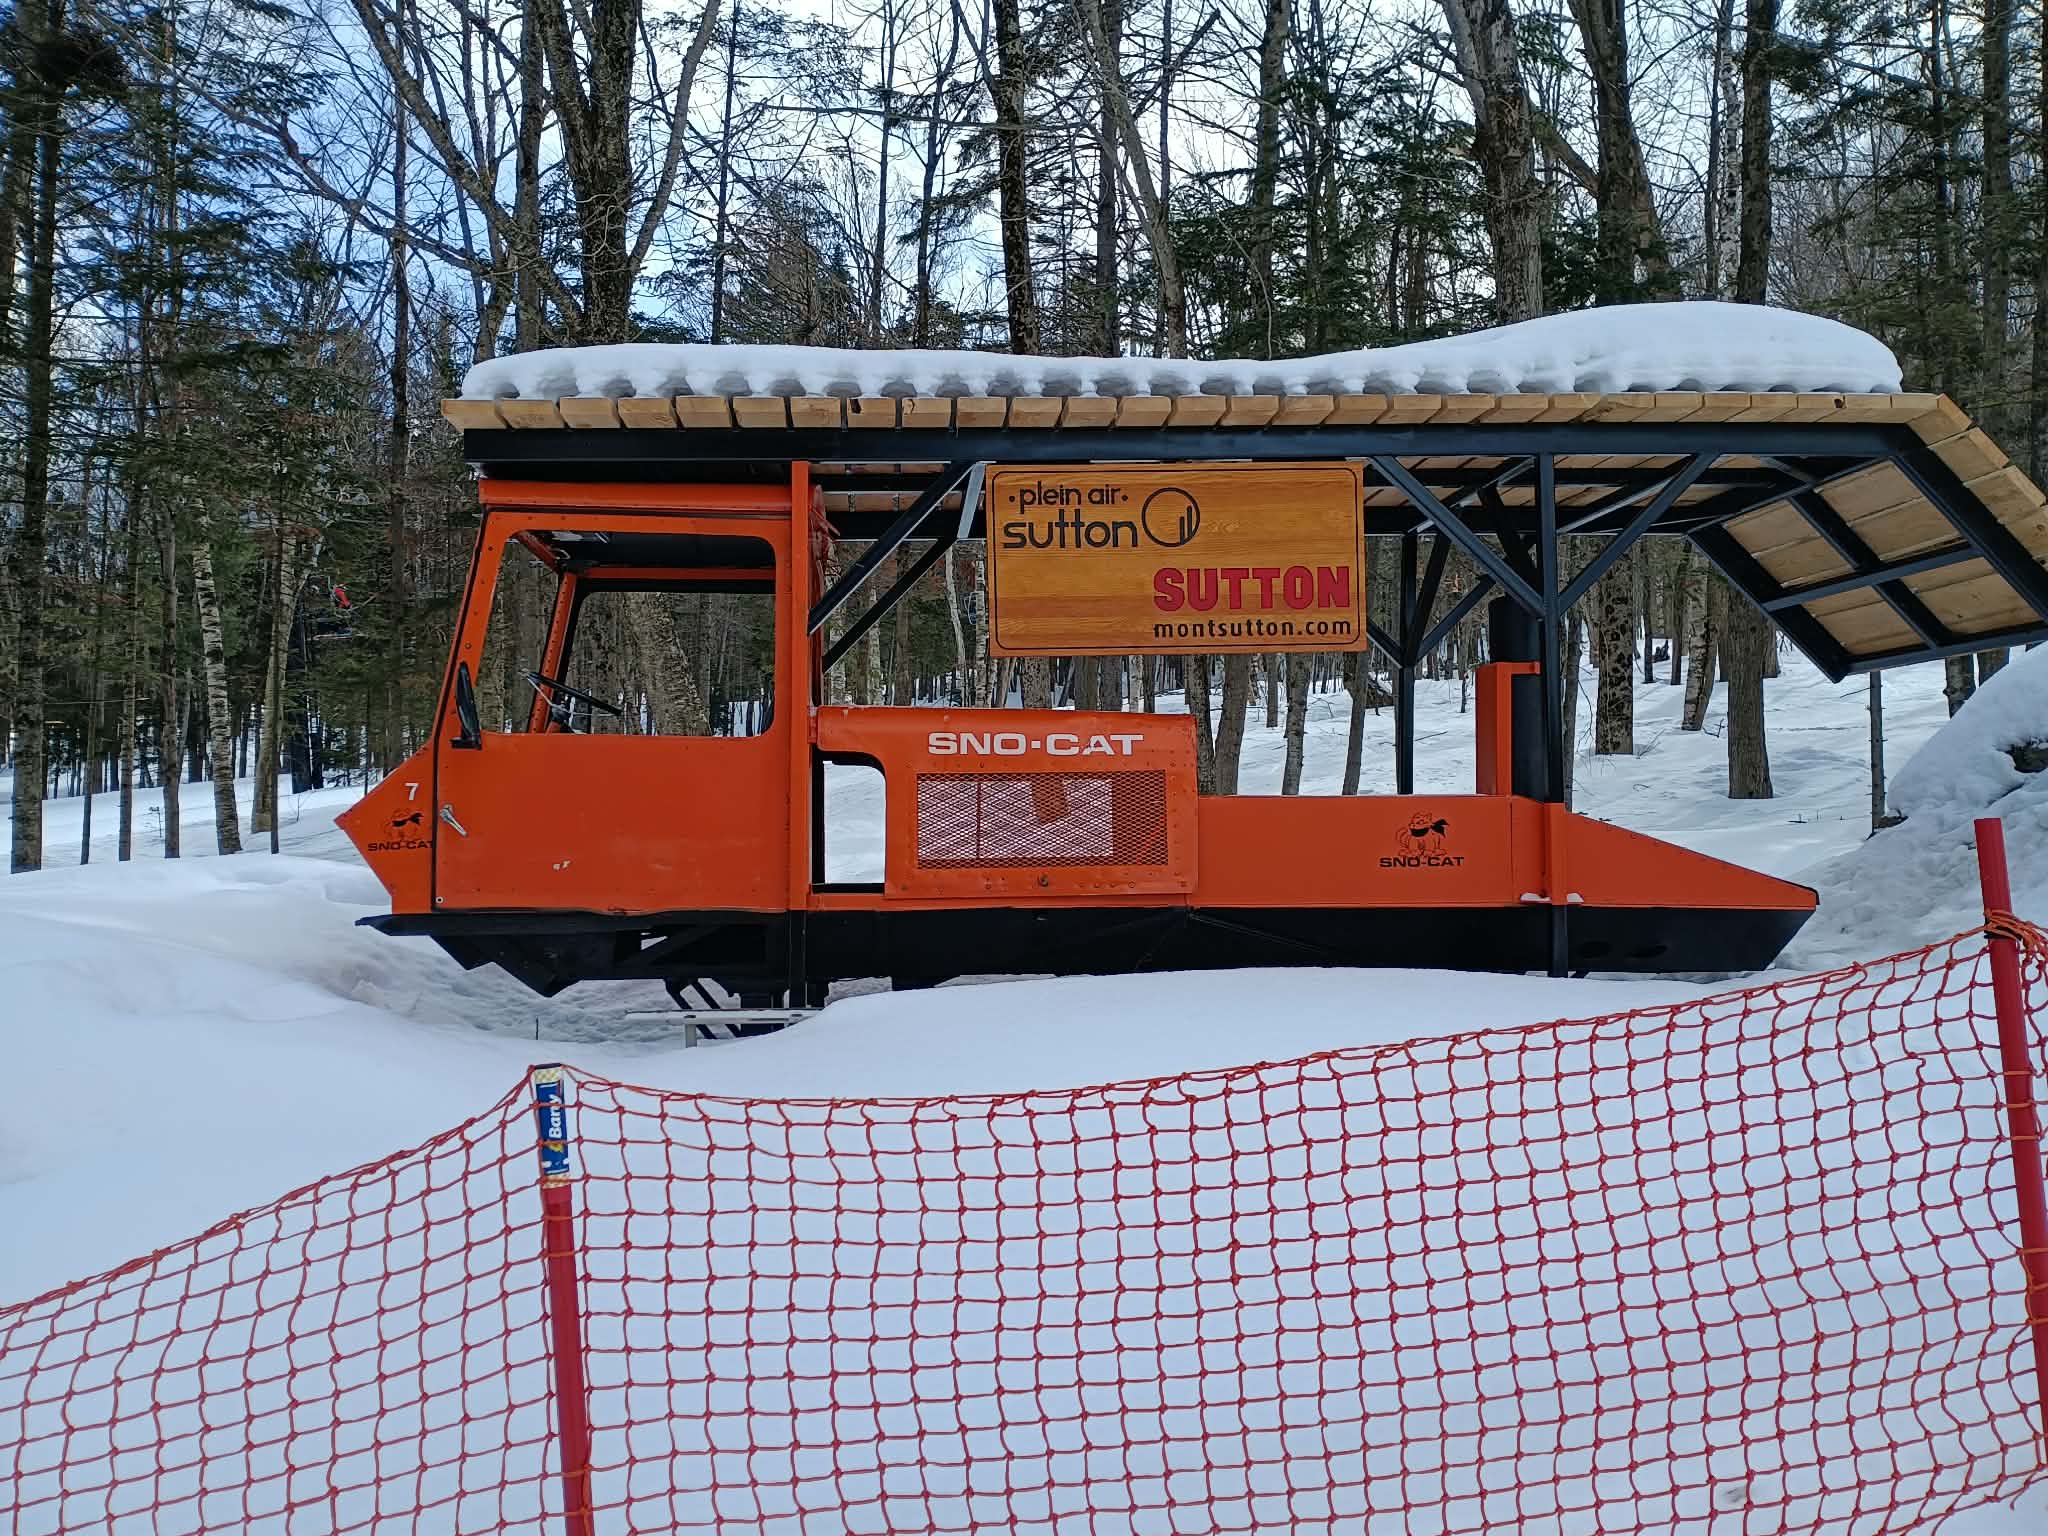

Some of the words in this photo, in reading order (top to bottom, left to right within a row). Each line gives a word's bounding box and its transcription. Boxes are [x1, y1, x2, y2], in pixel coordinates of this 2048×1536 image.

[1002, 508, 1138, 549] sutton
[1153, 565, 1351, 612] SUTTON
[1153, 619, 1351, 639] montsutton.com
[405, 782, 419, 801] 7
[1379, 856, 1465, 868] SNO-CAT
